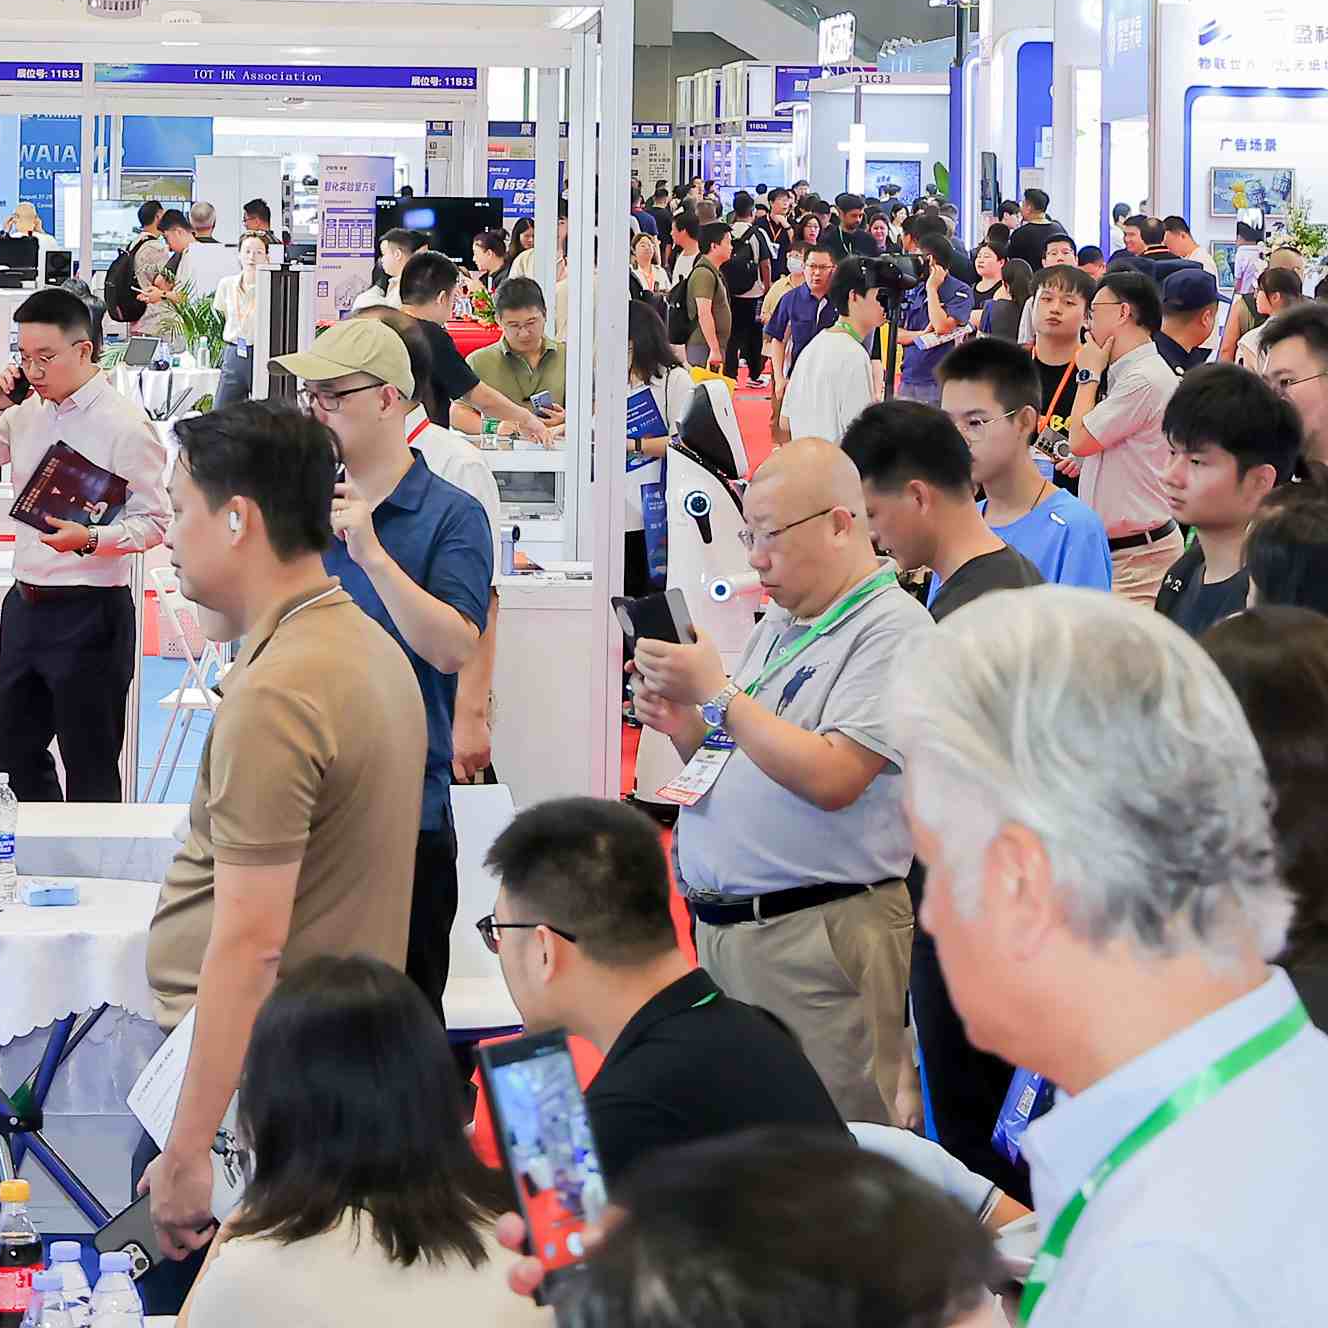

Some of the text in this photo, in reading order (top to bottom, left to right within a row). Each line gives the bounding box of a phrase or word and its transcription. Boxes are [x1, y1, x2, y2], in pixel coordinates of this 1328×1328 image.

[193, 69, 322, 83] IOT HK Association
[858, 75, 891, 84] 11C33
[1220, 137, 1277, 152] 广告场景
